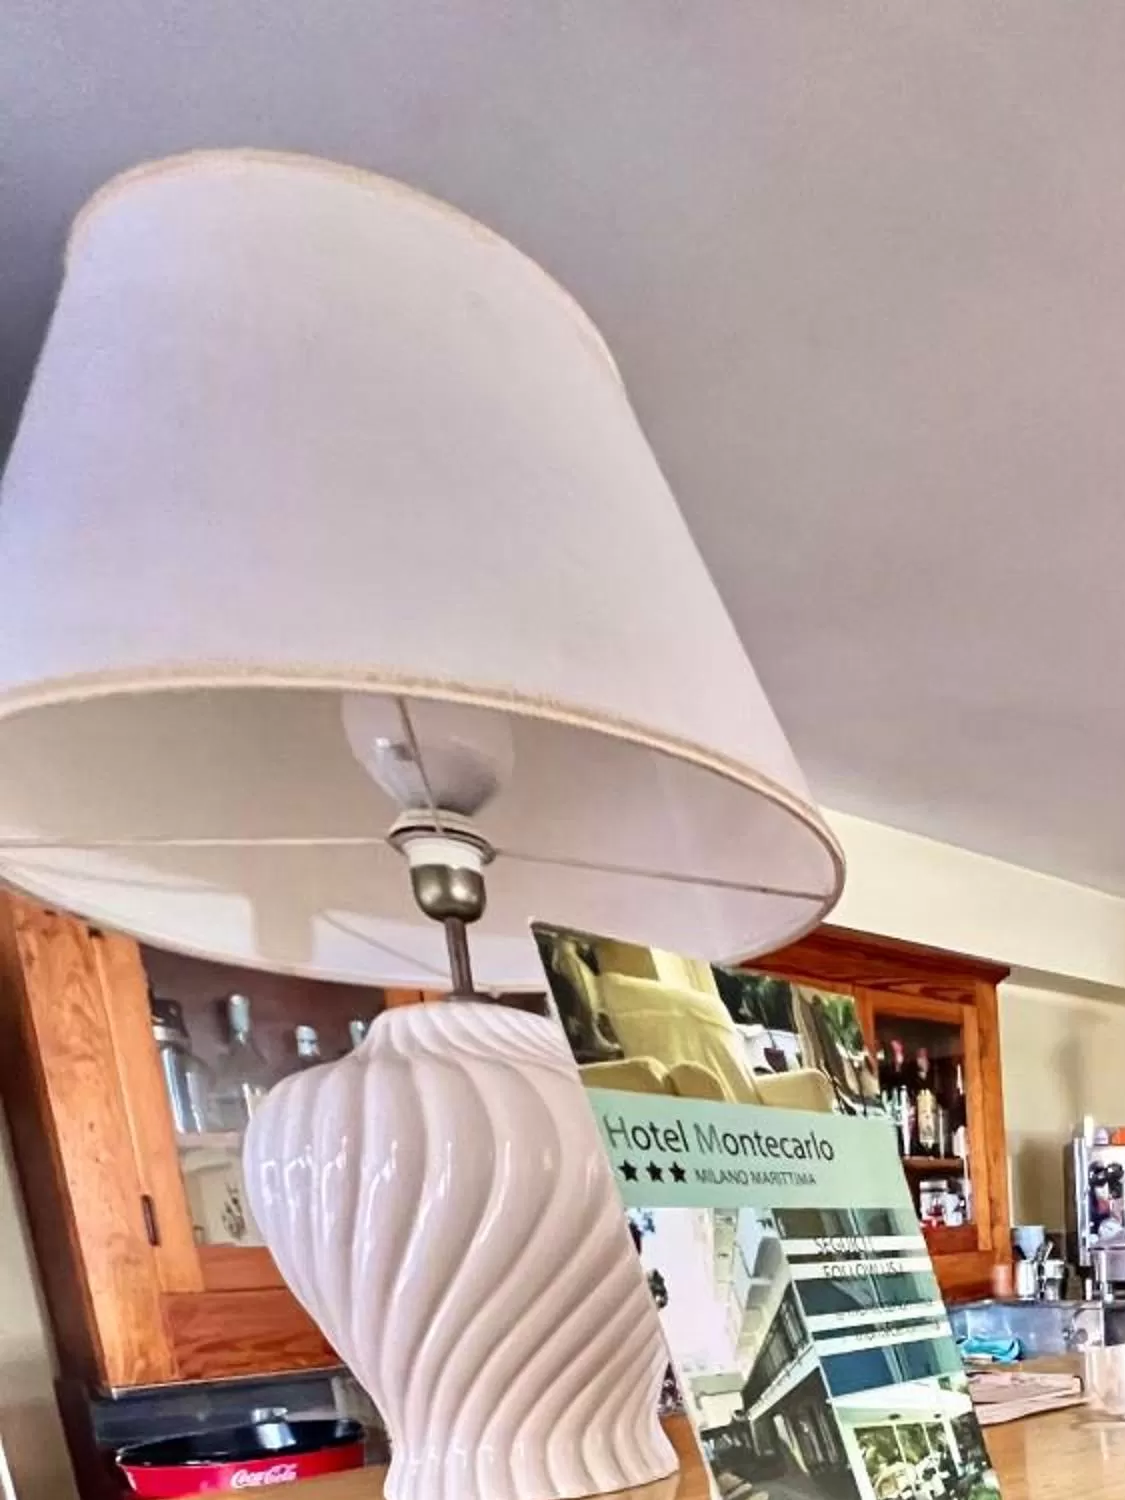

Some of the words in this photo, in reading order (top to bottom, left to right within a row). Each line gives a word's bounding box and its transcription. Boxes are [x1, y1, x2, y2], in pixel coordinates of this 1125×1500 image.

[603, 1115, 690, 1152] Hotel
[692, 1121, 836, 1161] Montecarlo
[694, 1167, 748, 1185] MILANO
[750, 1169, 817, 1187] MARITTIMA
